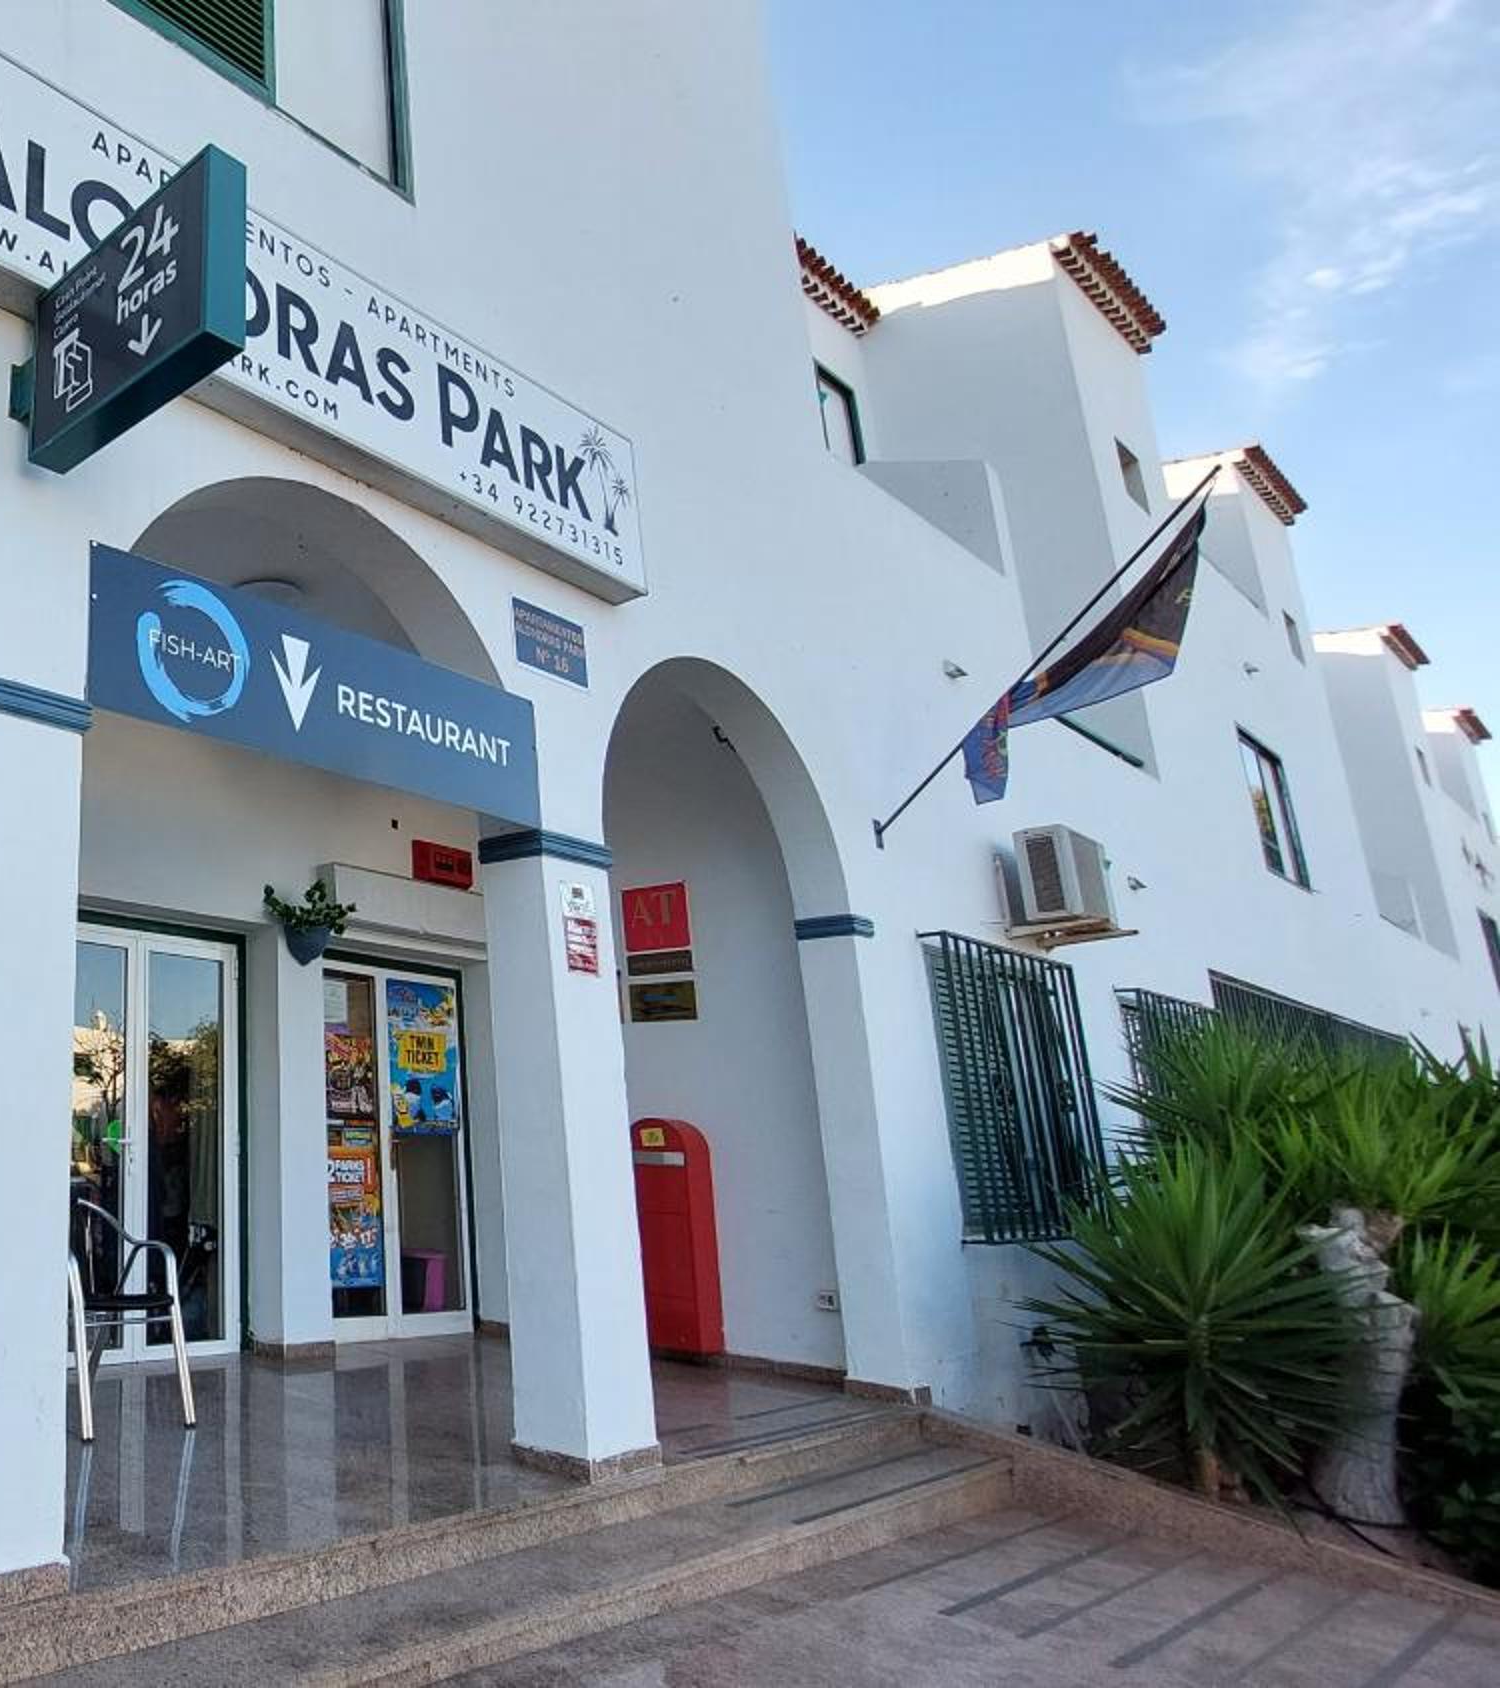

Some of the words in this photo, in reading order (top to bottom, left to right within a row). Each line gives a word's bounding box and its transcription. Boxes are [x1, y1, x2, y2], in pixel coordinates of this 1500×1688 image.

[117, 204, 180, 294] 24
[116, 260, 177, 325] horas
[367, 296, 515, 397] APARTMENTS
[437, 362, 593, 522] PARK
[459, 472, 499, 502] +34
[513, 495, 624, 566] 922731315
[148, 628, 241, 676] FISH-ART
[336, 683, 511, 767] RESTAURANT
[405, 1049, 440, 1065] TICKET
[409, 1035, 435, 1050] TWIN
